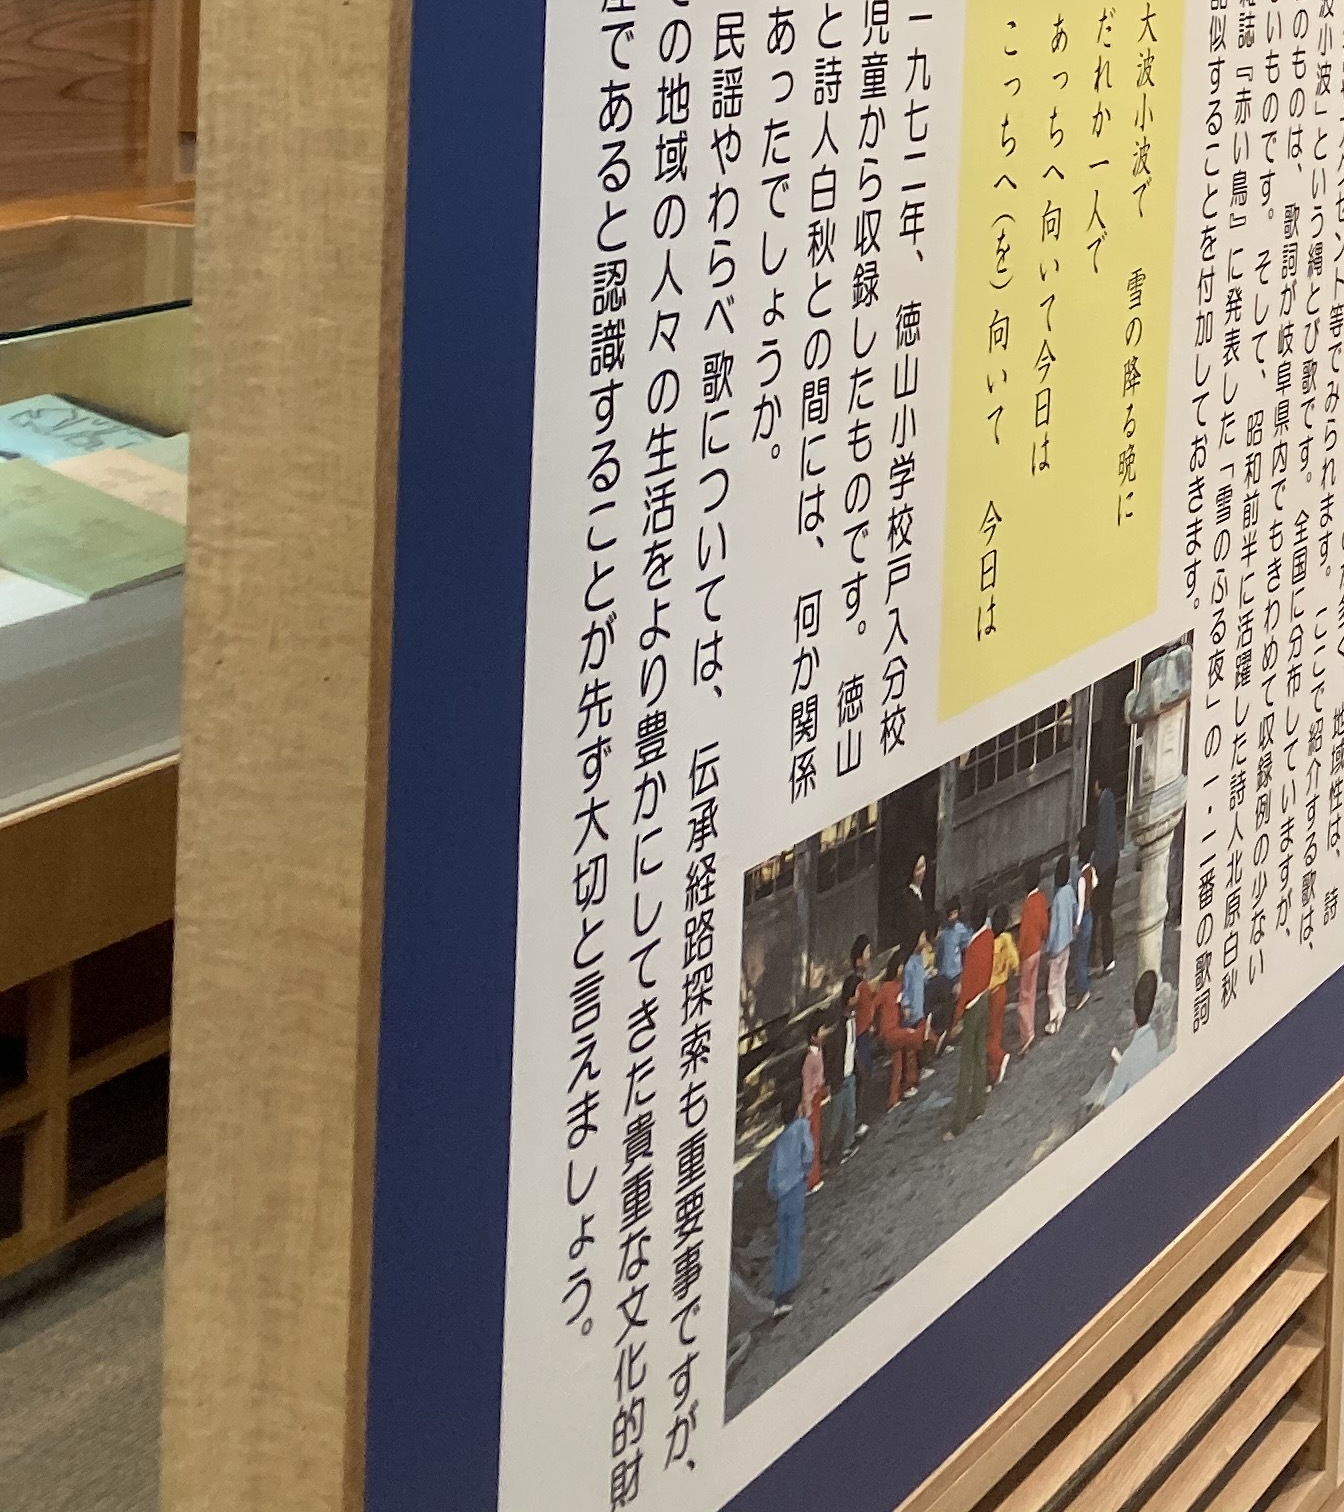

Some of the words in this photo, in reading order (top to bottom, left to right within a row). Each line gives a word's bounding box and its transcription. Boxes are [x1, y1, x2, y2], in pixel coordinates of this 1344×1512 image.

[1085, 7, 1113, 274] だれか一人で
[1131, 1, 1158, 218] 大波小波で
[1116, 266, 1146, 527] 雪の降る晩に
[976, 499, 1002, 642] 今日は
